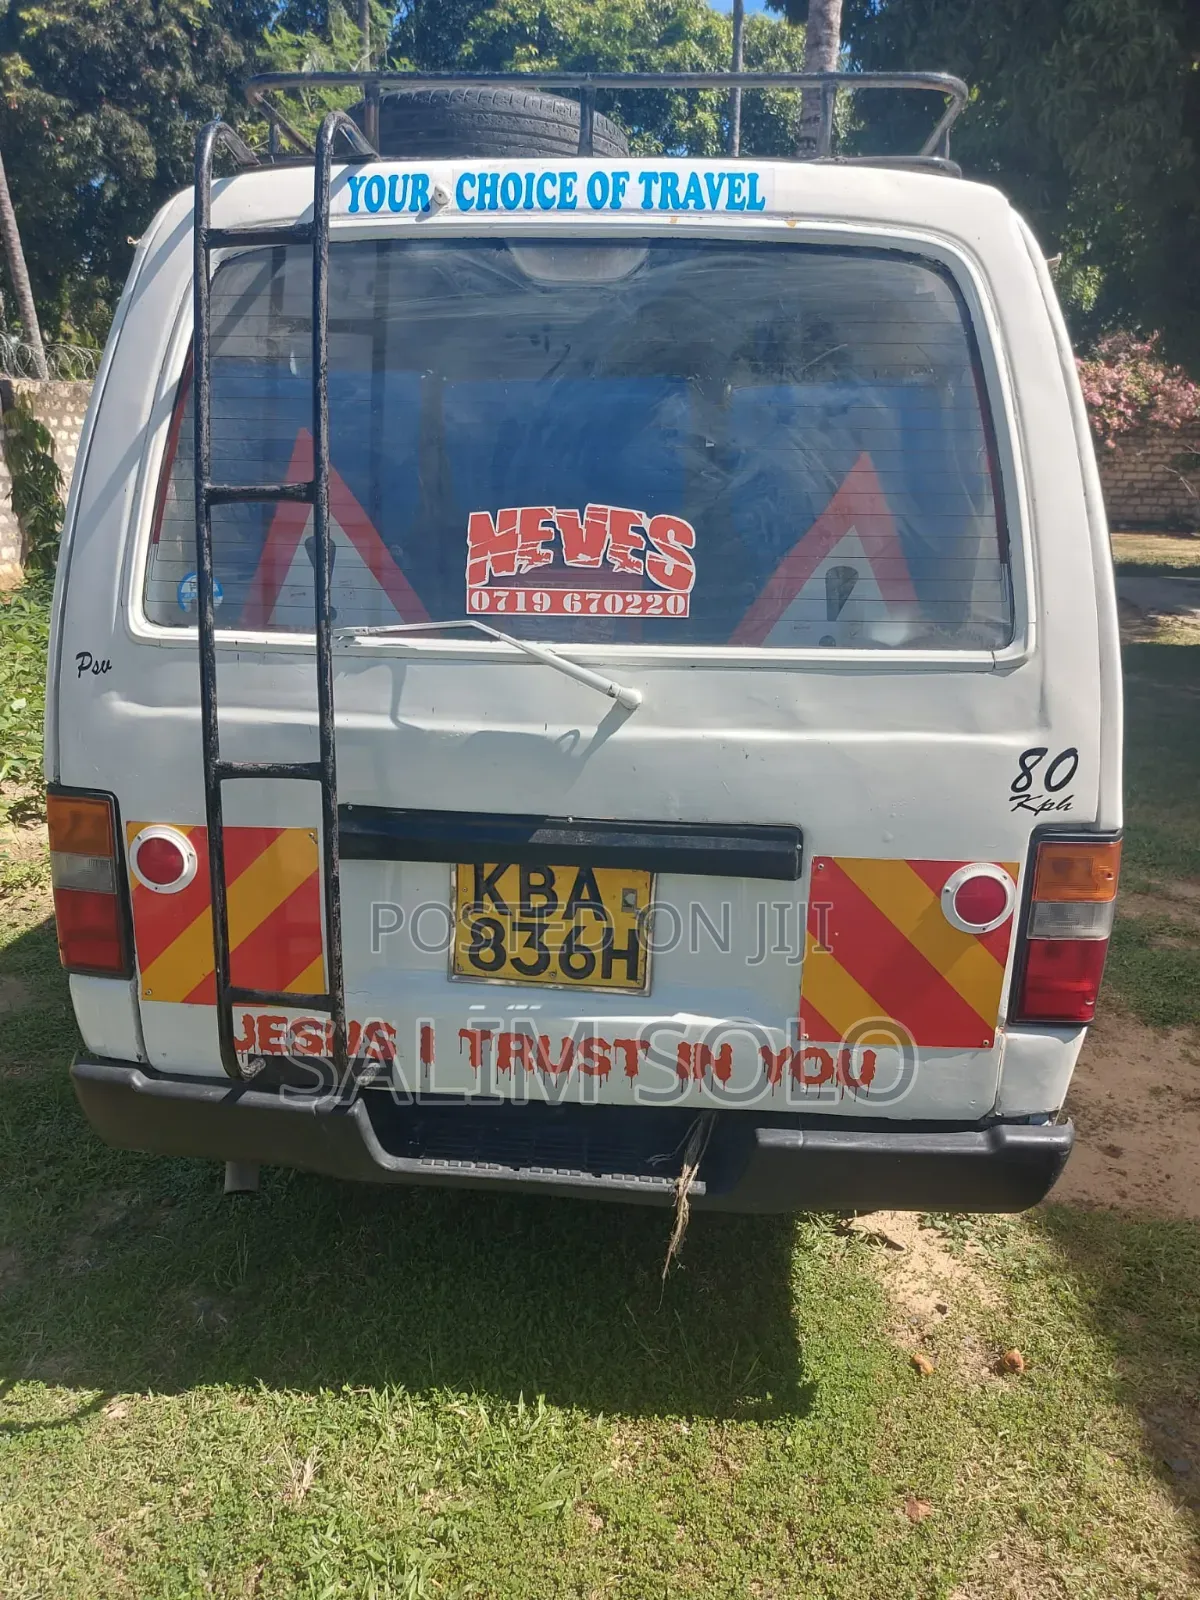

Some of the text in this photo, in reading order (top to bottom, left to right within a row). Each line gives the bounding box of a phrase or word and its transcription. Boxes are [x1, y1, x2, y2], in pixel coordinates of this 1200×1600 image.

[346, 171, 766, 214] YOUR CHOICE OF TRAVEL
[466, 503, 696, 592] NEVES
[471, 590, 685, 615] 0719 670220
[1010, 747, 1079, 793] 80
[1008, 794, 1074, 816] Kph
[474, 863, 608, 921] KBA
[468, 917, 640, 981] 836H
[233, 1013, 877, 1102] JESUS I TRUST IN YOU
